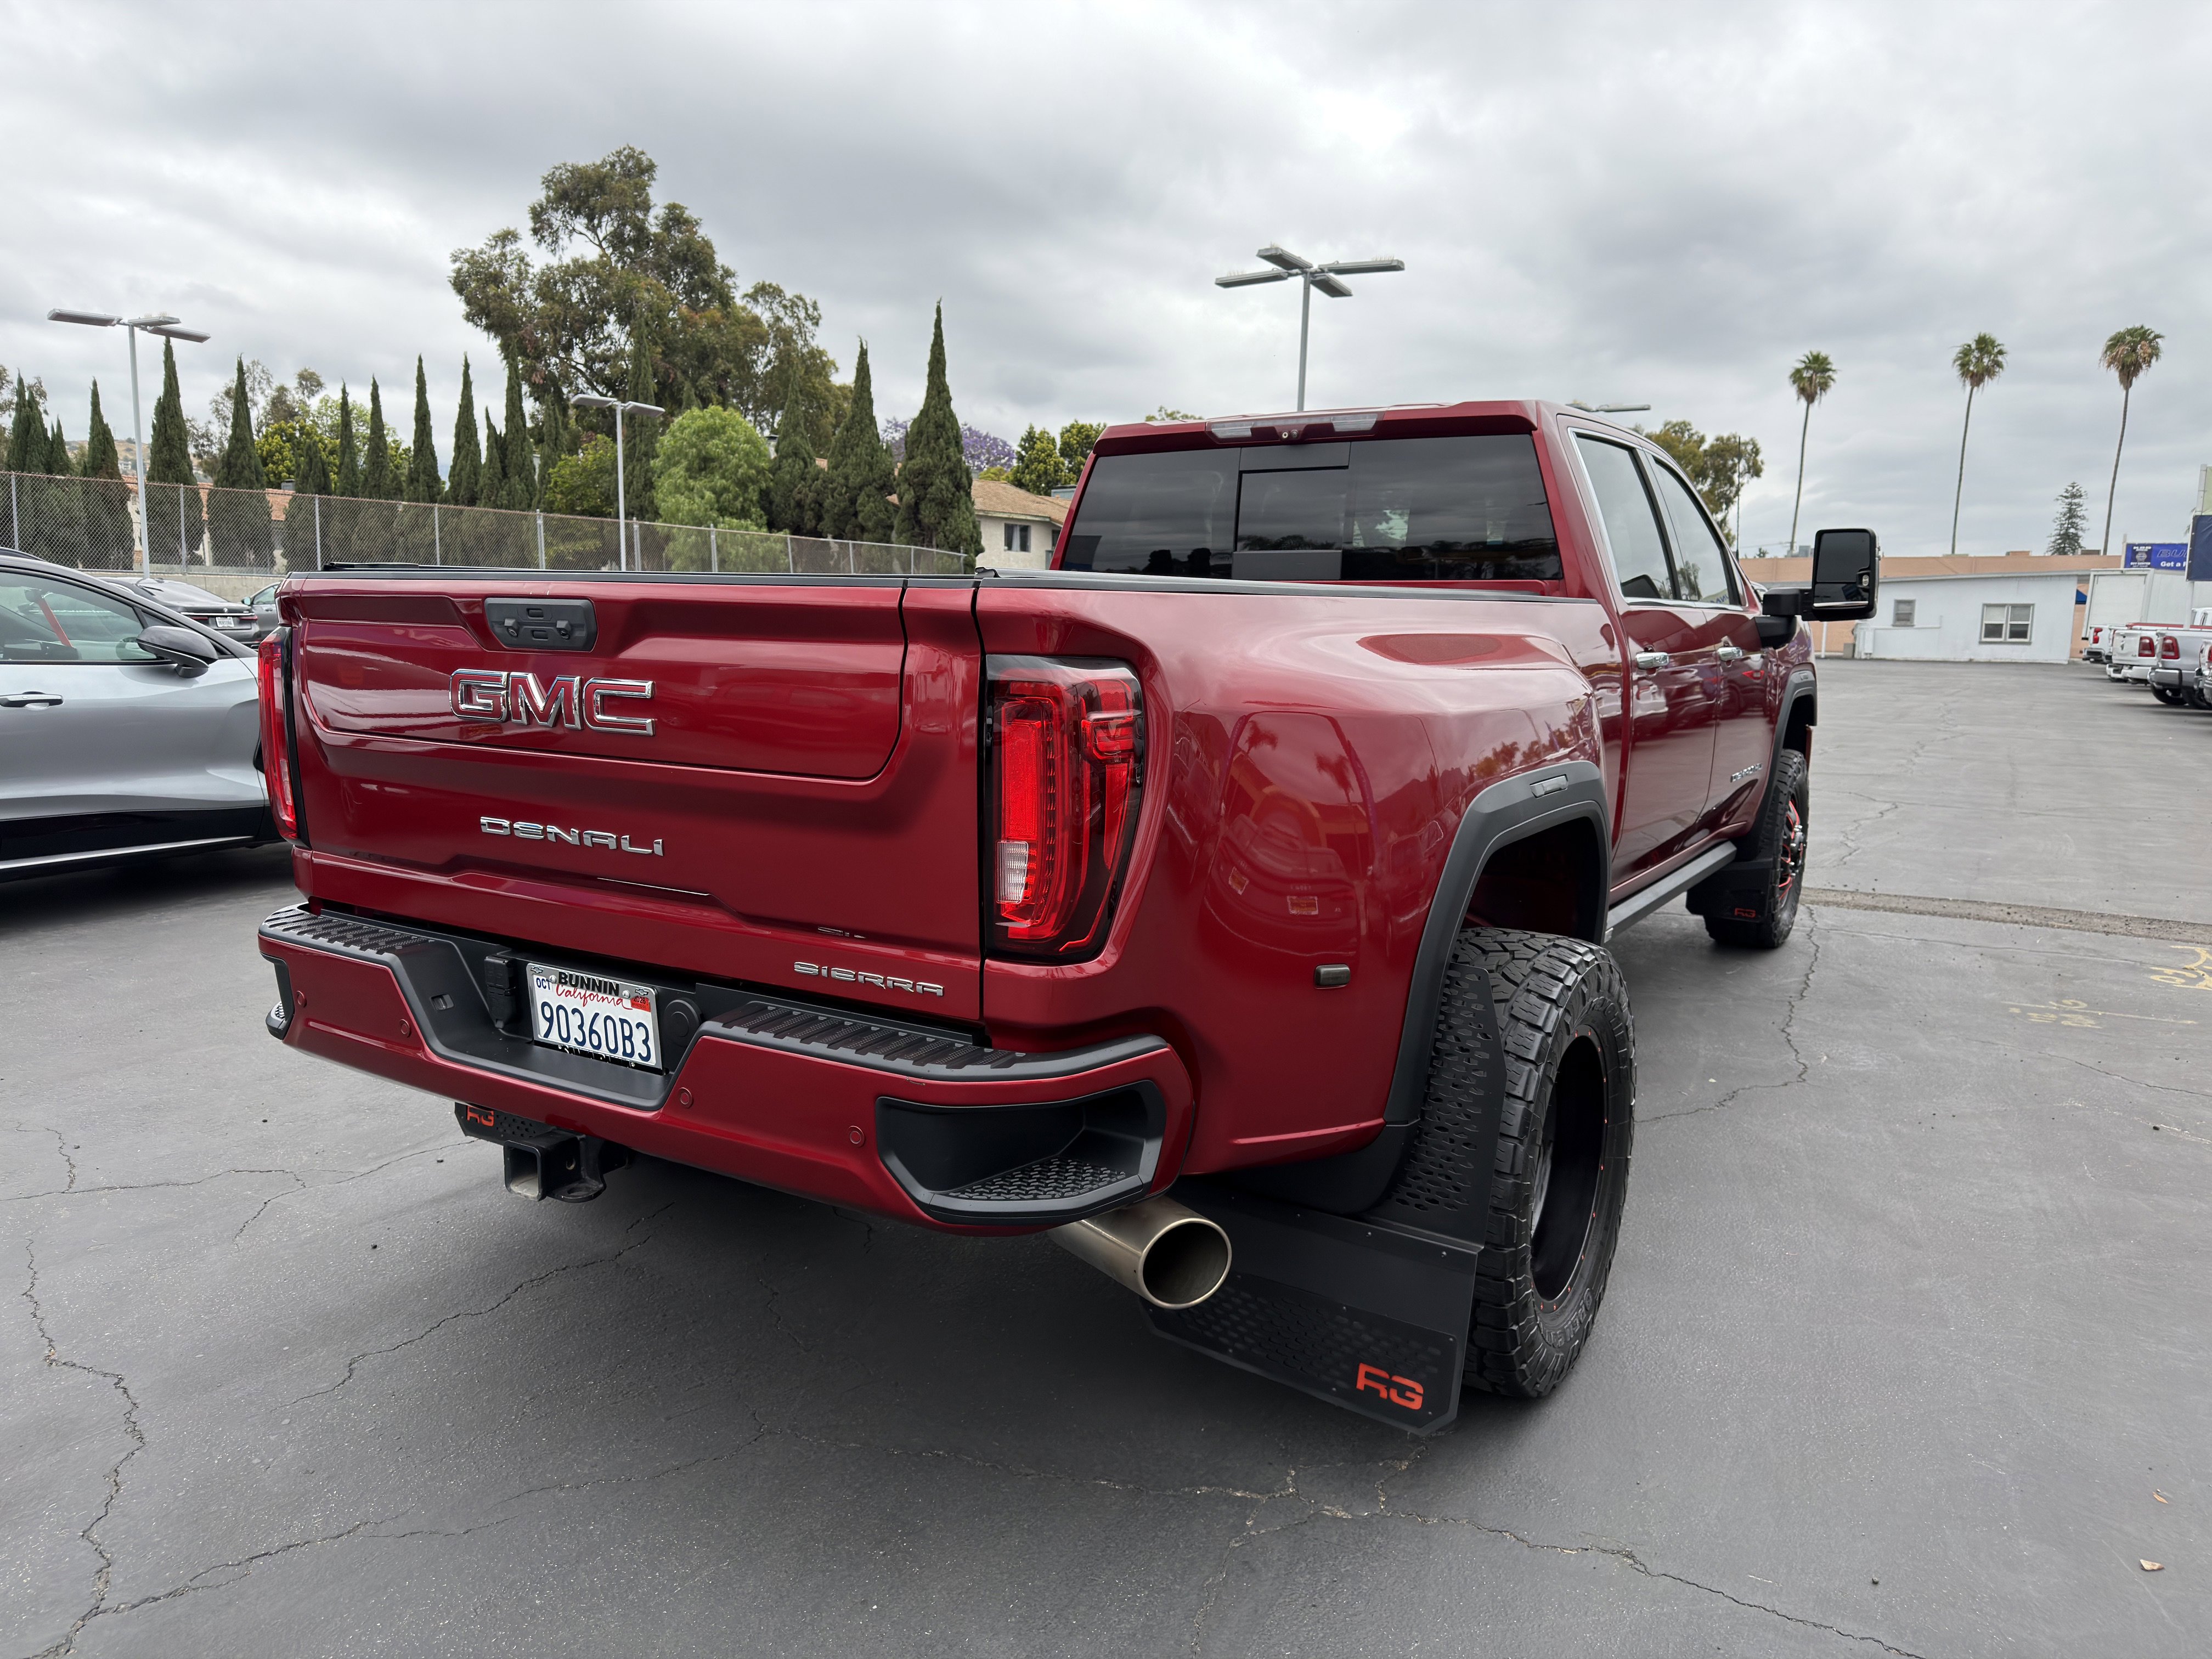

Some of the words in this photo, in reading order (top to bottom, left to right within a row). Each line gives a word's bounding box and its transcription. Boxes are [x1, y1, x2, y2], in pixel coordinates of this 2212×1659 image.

[449, 668, 656, 736] GMC
[480, 816, 664, 856] DENALI
[536, 977, 552, 990] OCT
[558, 970, 620, 997] BUNNIN
[794, 962, 944, 997] SIERRA
[556, 983, 633, 1009] California
[633, 995, 646, 1005] 2026
[467, 1105, 494, 1126] RG
[1356, 1362, 1424, 1410] RG
